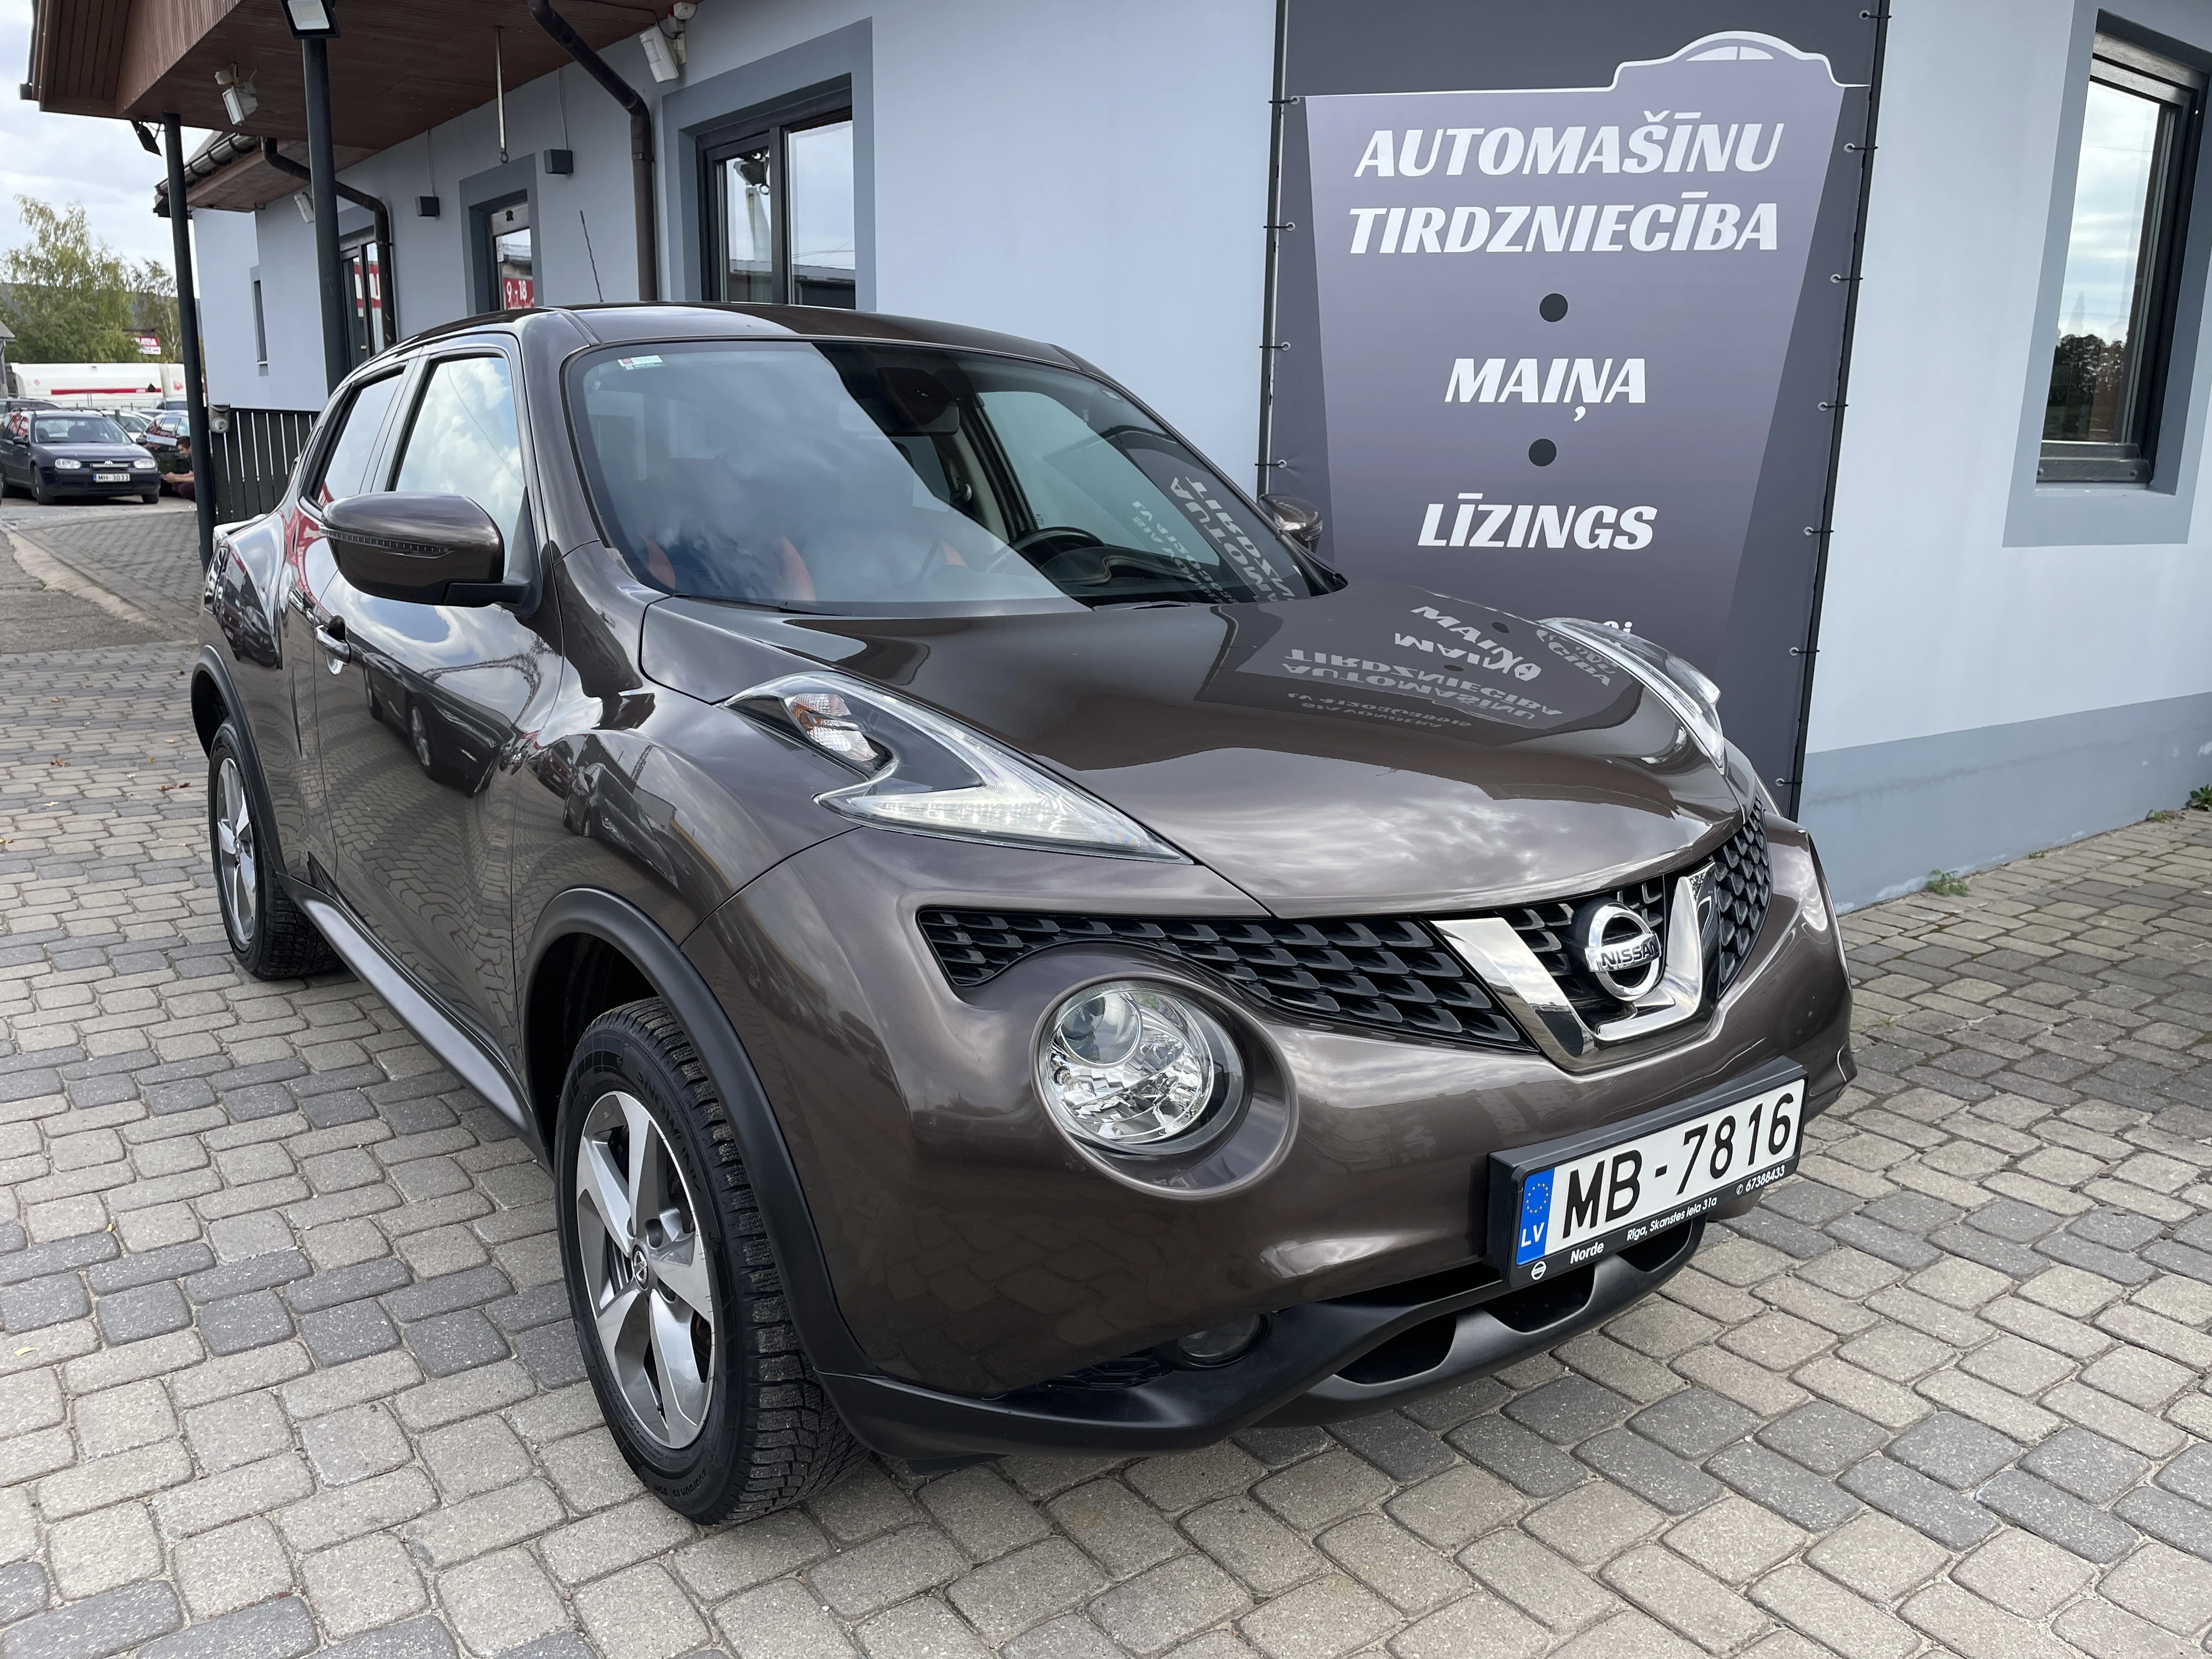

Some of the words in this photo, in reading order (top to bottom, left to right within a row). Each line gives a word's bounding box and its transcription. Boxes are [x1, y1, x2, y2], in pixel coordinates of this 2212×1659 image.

[1353, 110, 1784, 178] AUTOMAŠĪNU
[1348, 191, 1778, 254] TIRDZNIECĪBA
[1444, 358, 1647, 422] MAIŅA
[1417, 492, 1658, 551] LĪZINGS
[1600, 939, 1661, 967] NISSAN
[1562, 1092, 1795, 1240] MB-7816
[1745, 1164, 1785, 1192] 67388433
[1521, 1222, 1544, 1248] LV
[1626, 1224, 1648, 1242] Rīga,
[1649, 1210, 1685, 1233] Skanstes
[1686, 1202, 1702, 1218] iela
[1702, 1195, 1718, 1211] 31a
[1570, 1241, 1604, 1265] Norde
